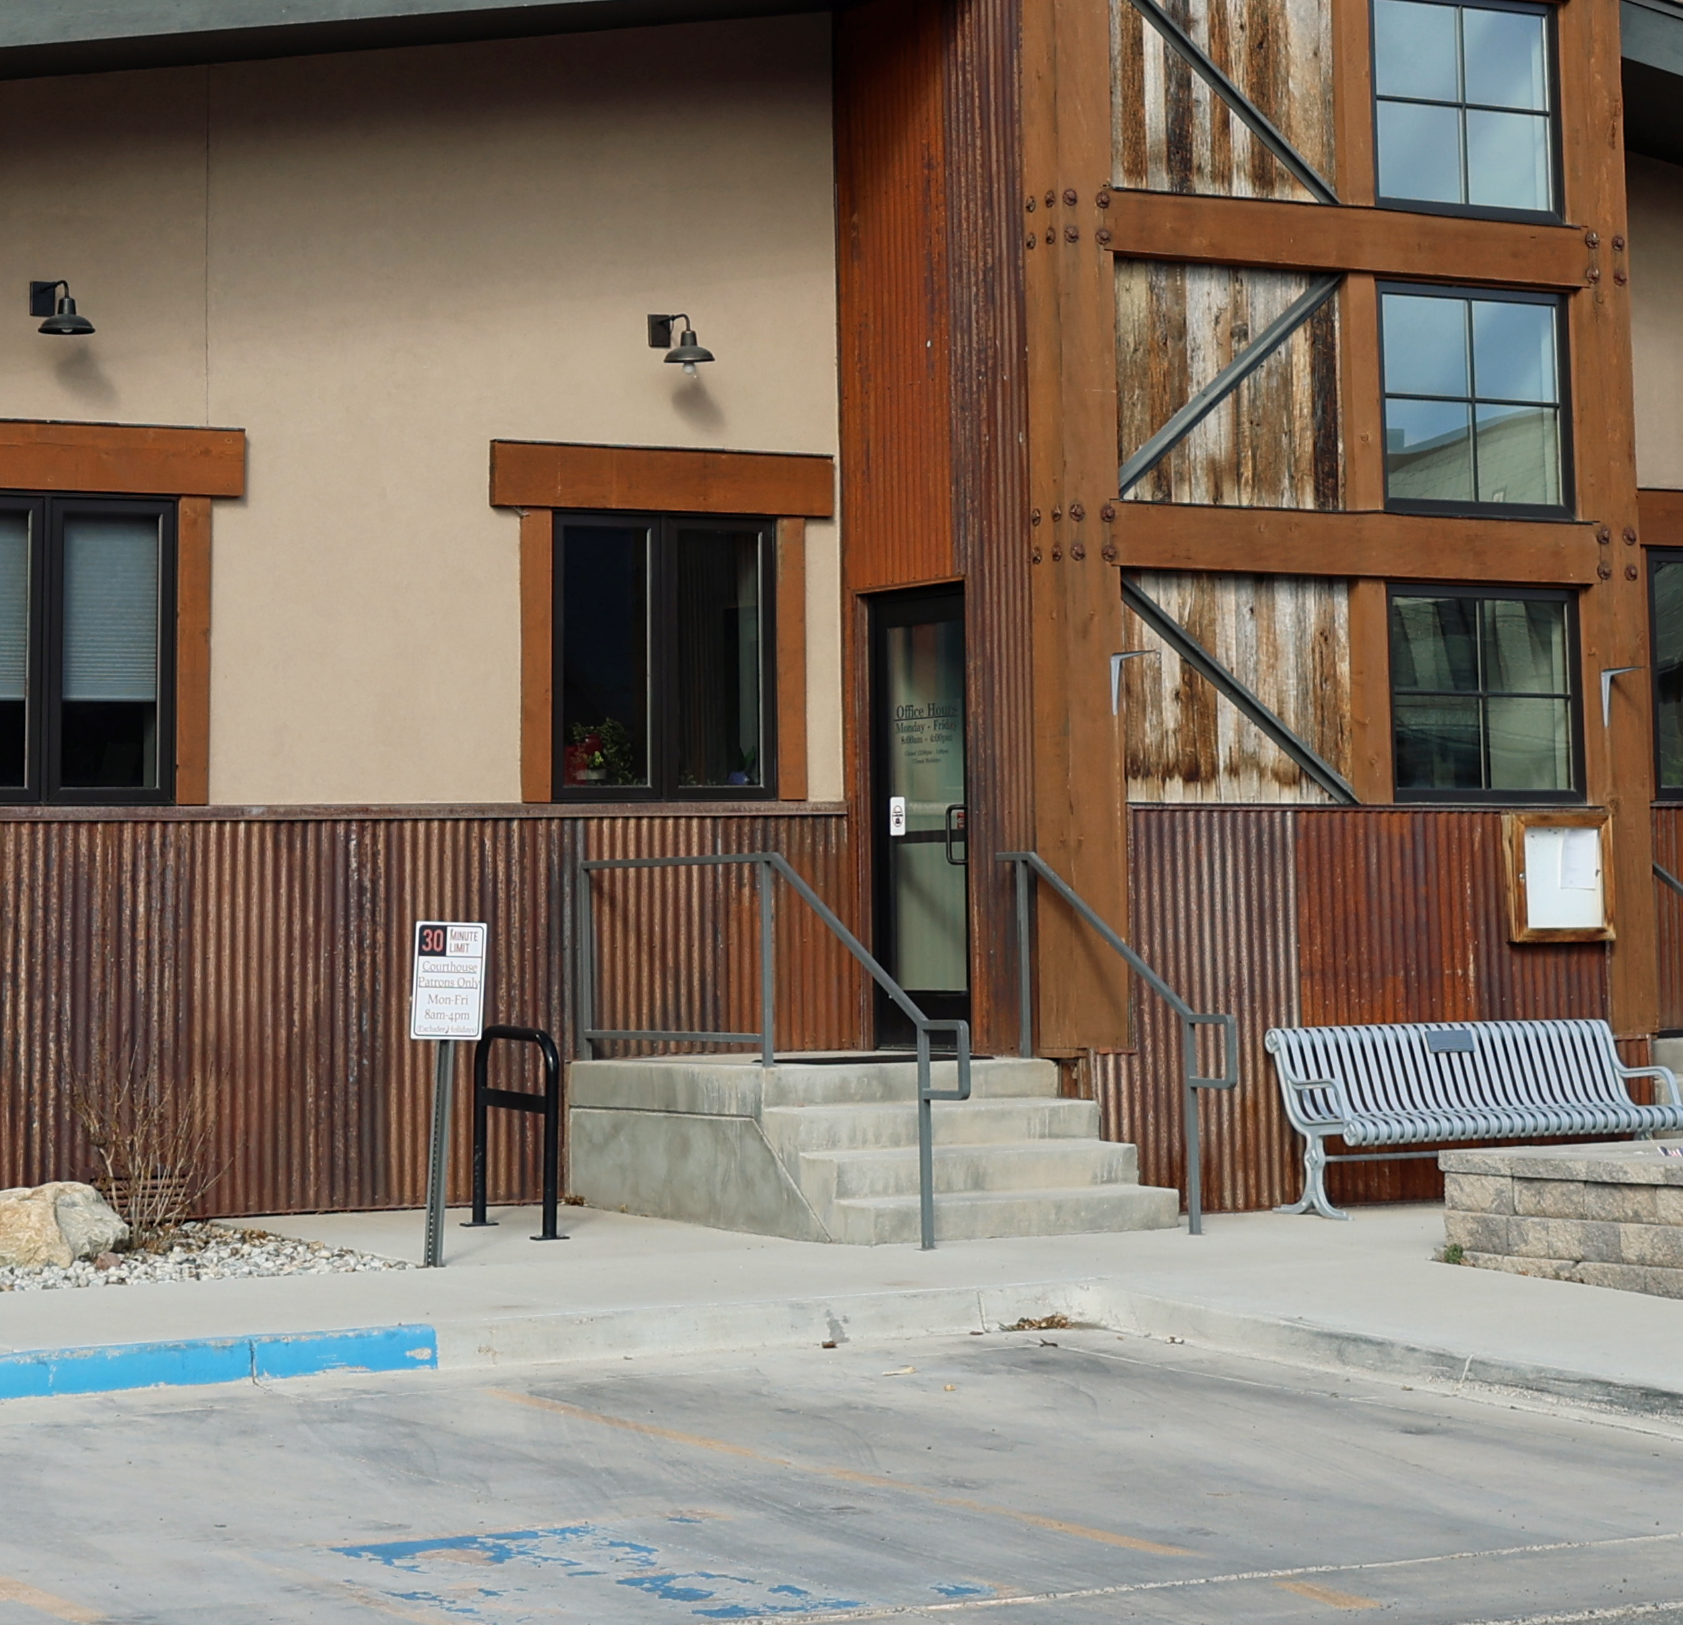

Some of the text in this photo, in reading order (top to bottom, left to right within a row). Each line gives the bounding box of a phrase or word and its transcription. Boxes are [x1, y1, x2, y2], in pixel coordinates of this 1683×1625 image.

[896, 704, 924, 720] Office
[896, 721, 924, 734] Monday
[422, 928, 444, 952] 30
[450, 930, 478, 942] MINUTE
[449, 943, 470, 954] LIMIT
[422, 961, 478, 973] Courthouse
[418, 976, 480, 989] Patrons Only
[427, 994, 469, 1005] Mon-Fri
[424, 1009, 470, 1022] 8am-4pm
